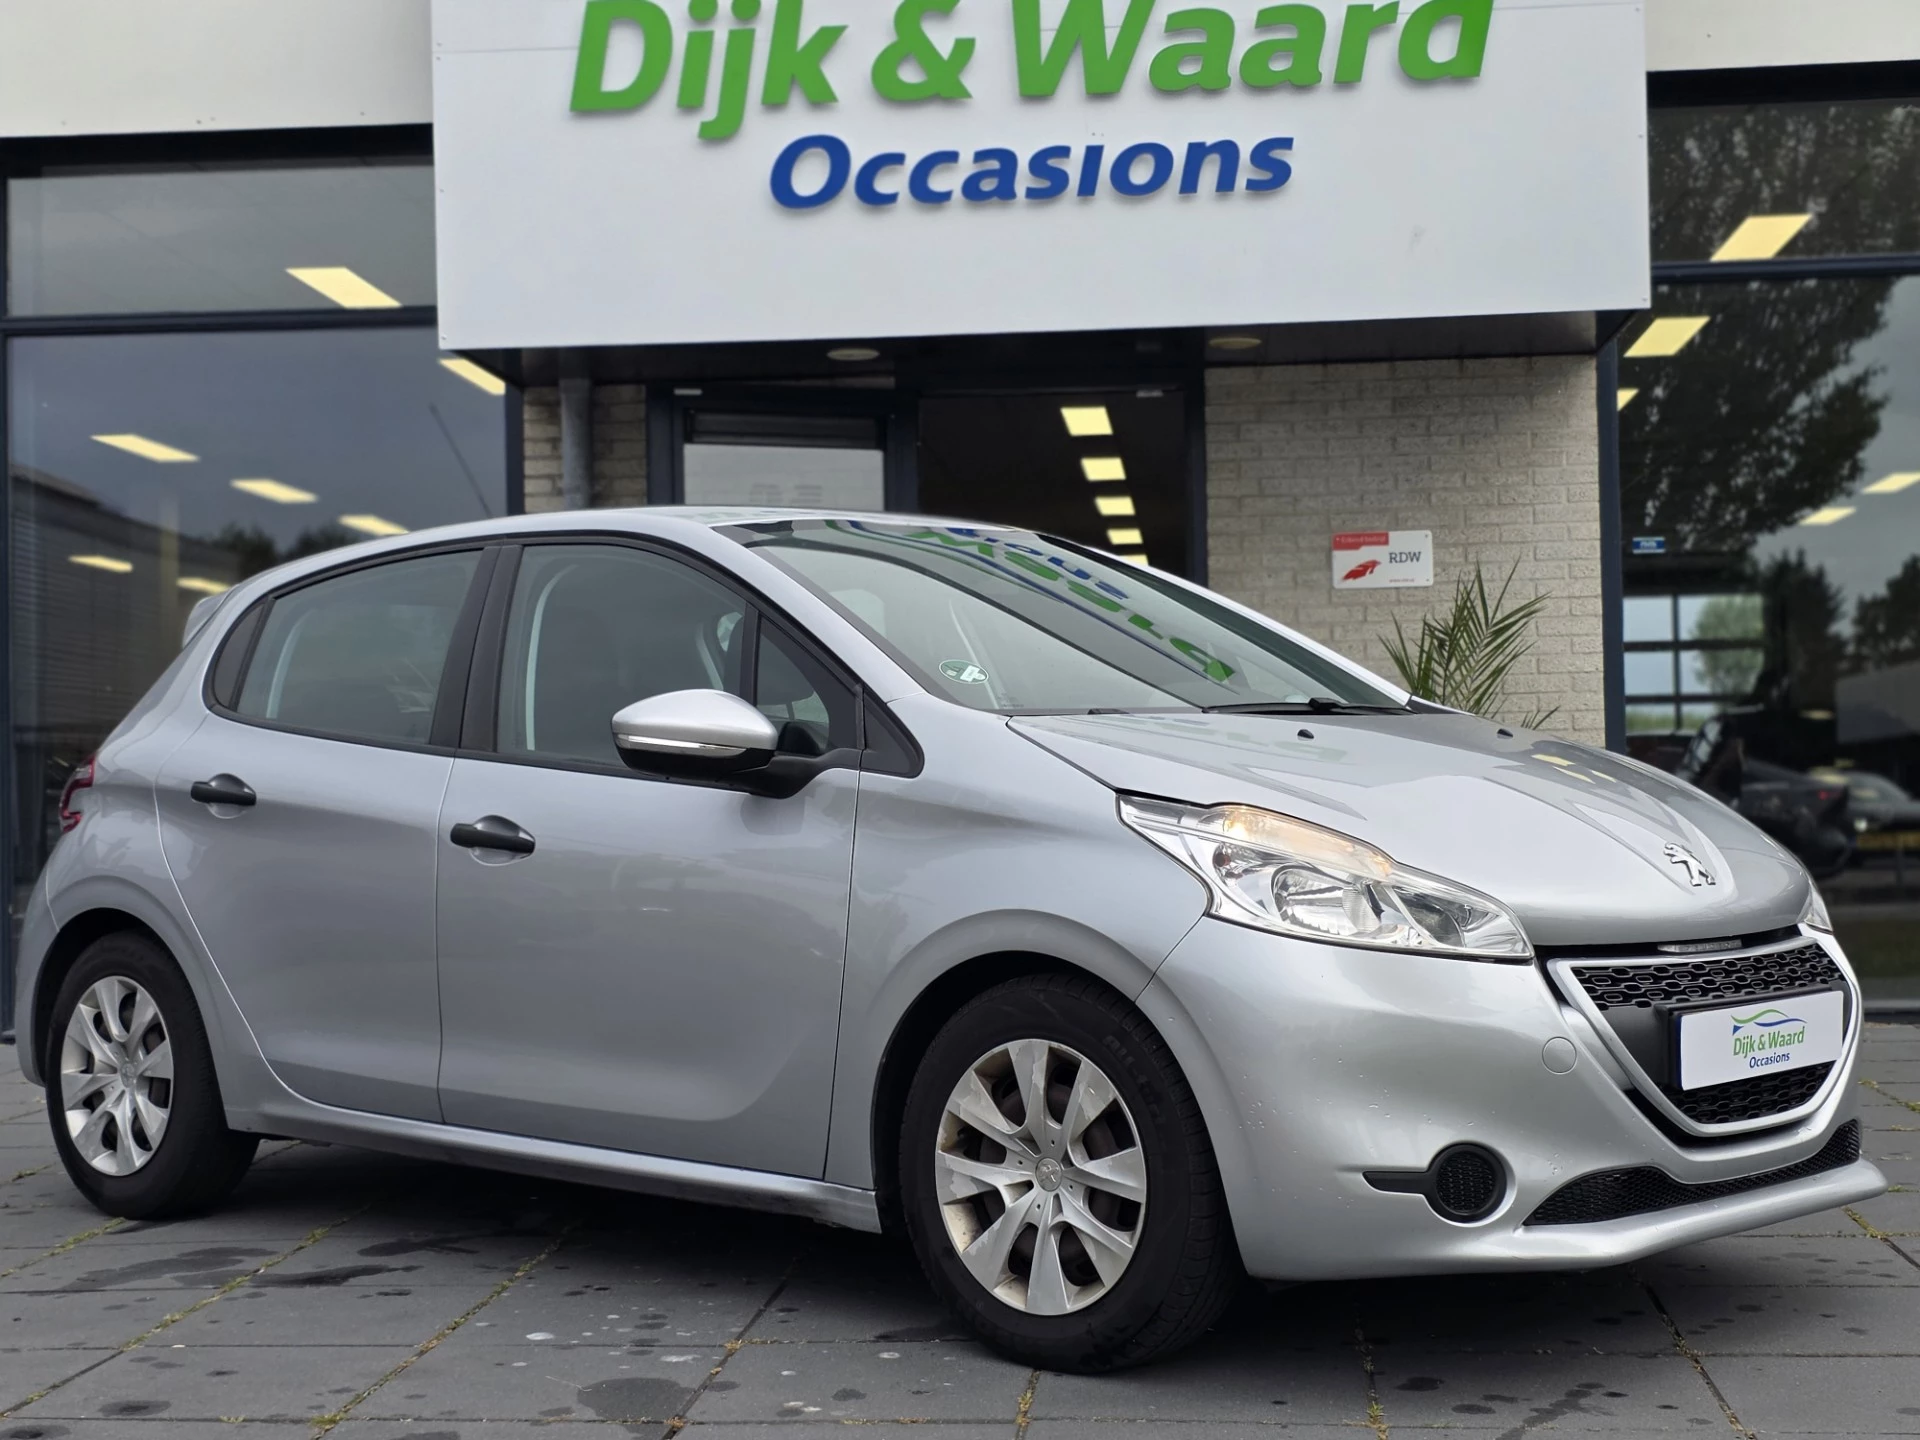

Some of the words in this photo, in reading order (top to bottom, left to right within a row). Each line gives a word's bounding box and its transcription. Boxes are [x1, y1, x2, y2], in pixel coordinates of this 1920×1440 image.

[569, 0, 848, 140] Dijk
[869, 0, 976, 101] &
[1010, 0, 1494, 98] Waard
[769, 134, 1295, 209] Occasions
[1388, 551, 1422, 564] RDW
[1733, 1035, 1755, 1058] Dijk
[1757, 1036, 1766, 1051] &
[1768, 1026, 1806, 1049] Waard
[1749, 1052, 1790, 1069] Occasions
